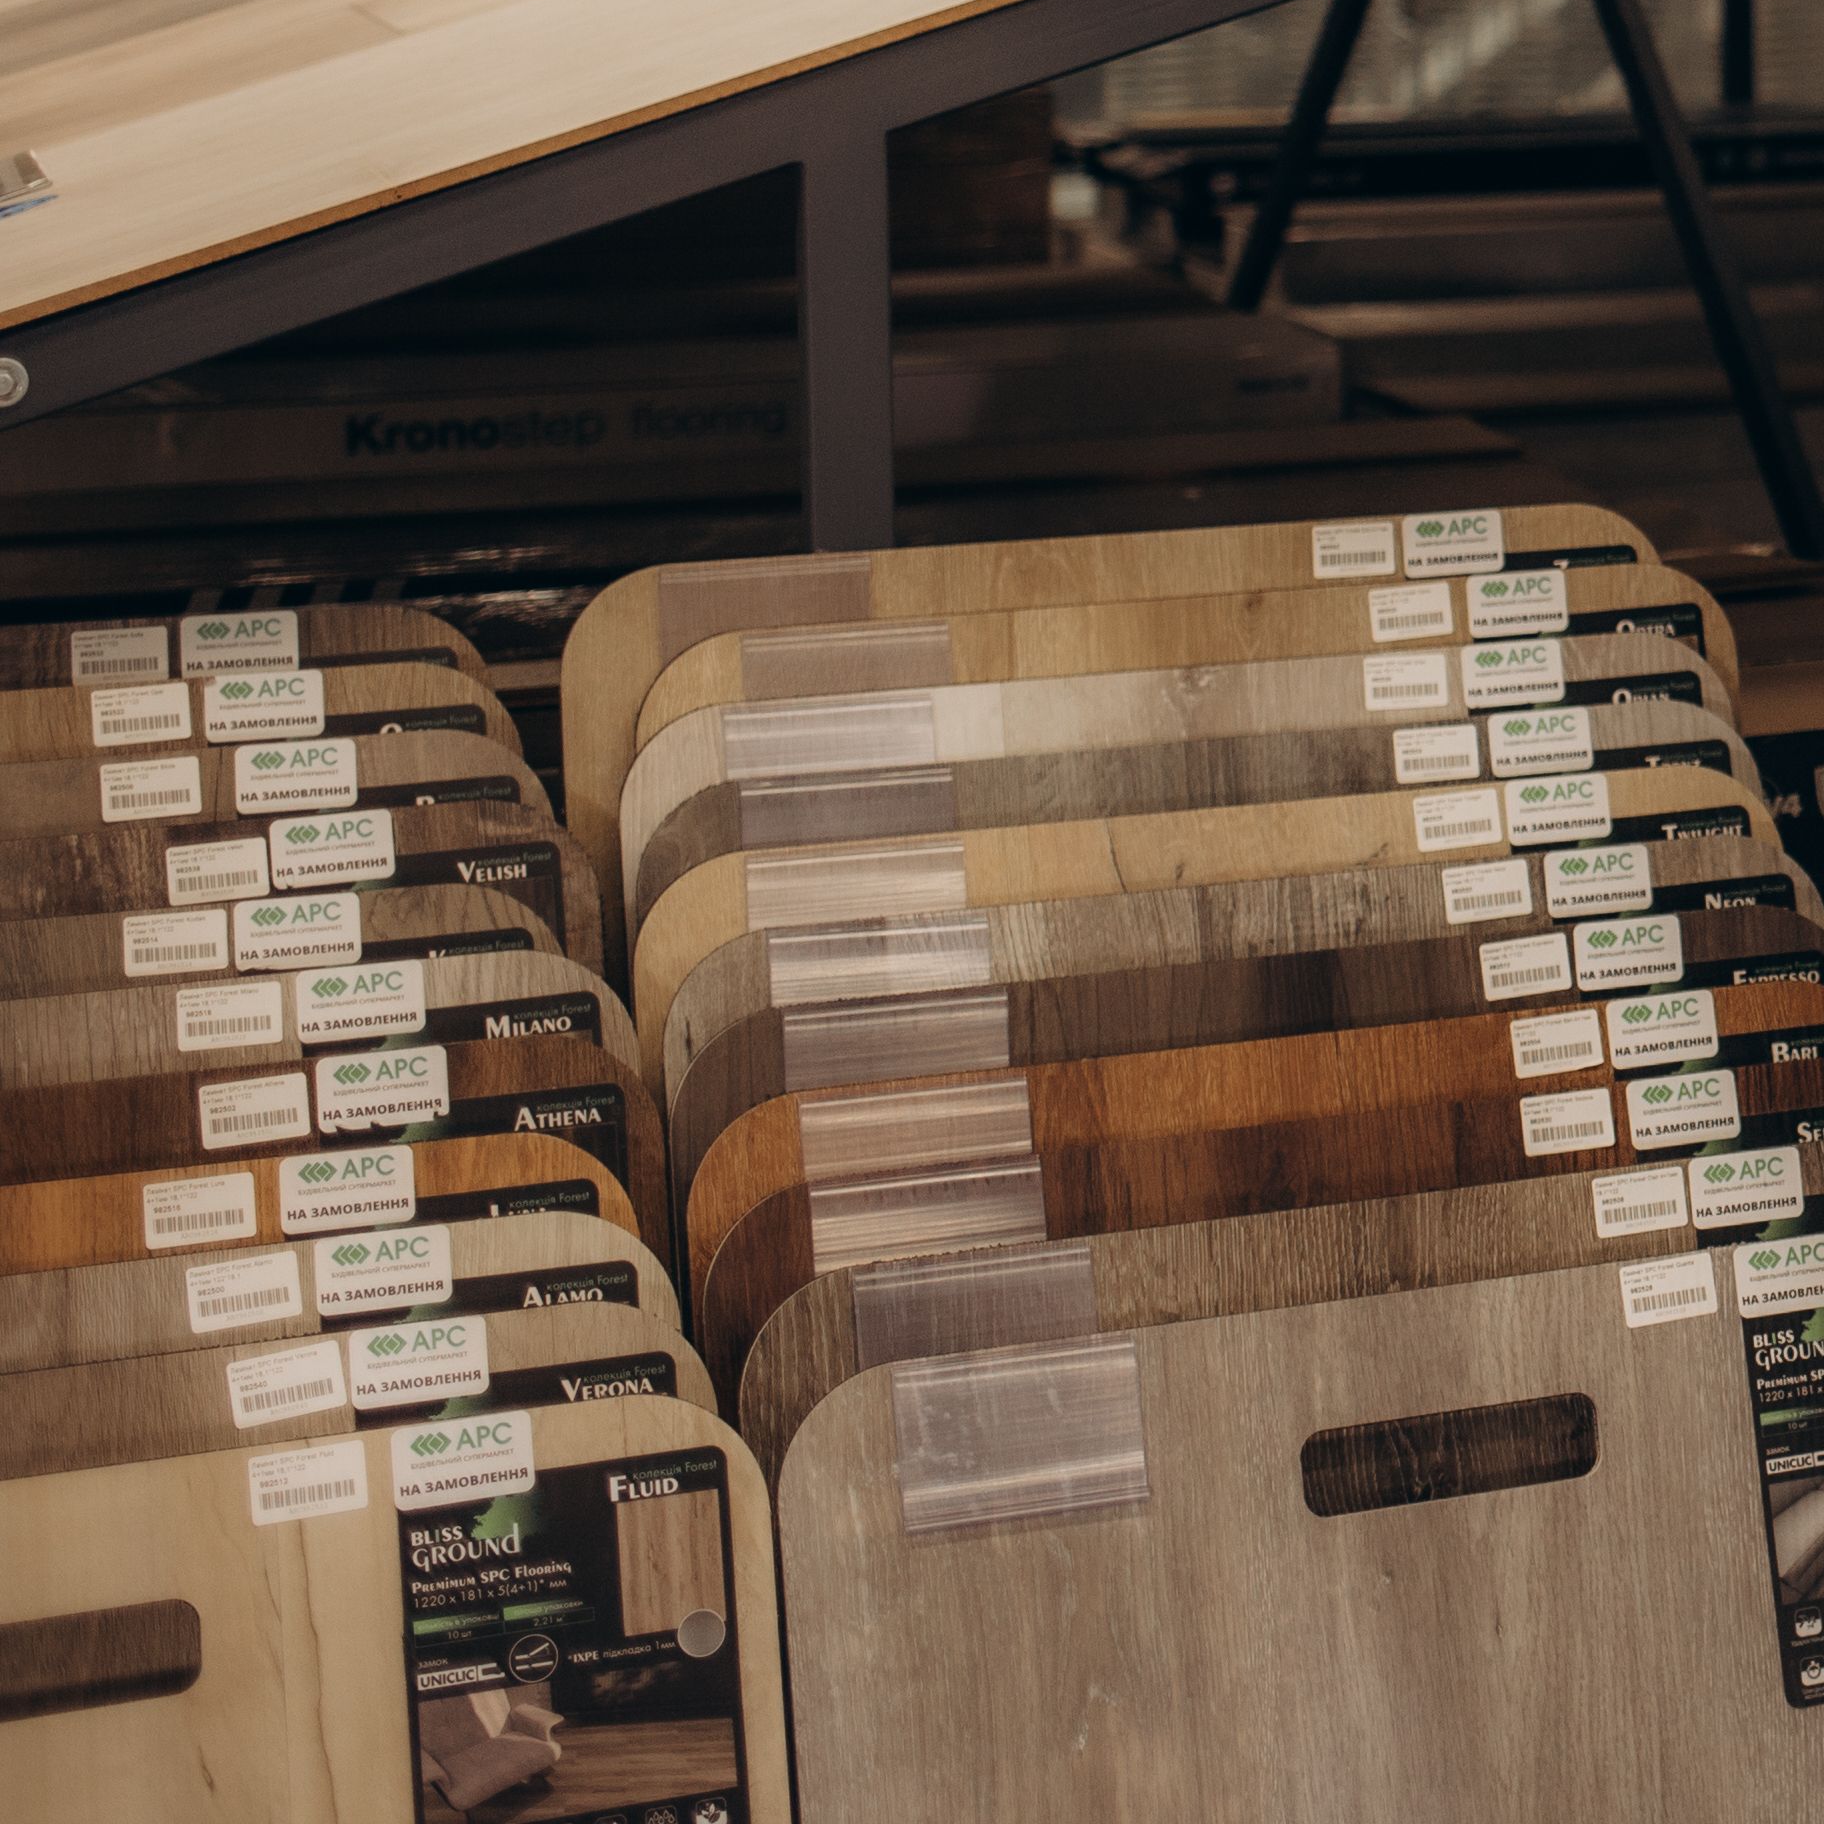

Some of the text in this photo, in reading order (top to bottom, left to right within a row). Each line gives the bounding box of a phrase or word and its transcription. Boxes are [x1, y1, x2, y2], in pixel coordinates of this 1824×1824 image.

[208, 657, 293, 670] ЗАМОВЛЕННЯ
[231, 716, 317, 729] ЗАМОВЛЕННЯ
[263, 786, 350, 801] ЗАМОВЛЕННЯ
[276, 857, 387, 877] НА ЗАМОВЛЕННЯ
[457, 860, 527, 883] VELISH
[1571, 890, 1646, 905] ЗАМОВЛЕННЯ
[241, 942, 354, 960] НА ЗАМОВЛЕННЯ
[1600, 962, 1676, 979] ЗАМОВЛЕННЯ
[301, 1012, 417, 1033] НА ЗАМОВЛЕННЯ
[485, 1015, 571, 1039] MILANO
[1616, 1036, 1712, 1057] НА ЗАМОВЛЕННЯ
[1771, 1042, 1818, 1064] BARI
[323, 1098, 441, 1121] НА ЗАМОВЛЕННЯ
[514, 1107, 601, 1132] ATHENA
[1636, 1117, 1734, 1138] НА ЗАМОВЛЕННЯ
[560, 1192, 590, 1202] Forest
[1696, 1197, 1797, 1217] НА ЗАМОВЛЕННЯ
[288, 1198, 409, 1220] НА ЗАМОВЛЕННЯ
[598, 1274, 628, 1284] Forest
[321, 1280, 444, 1304] НА ЗАМОВЛЕННЯ
[1742, 1296, 1758, 1306] НА
[1753, 1330, 1794, 1348] BLISS
[635, 1364, 666, 1376] Forest
[357, 1370, 481, 1396] НА ЗАМОВЛЕННЯ
[561, 1377, 653, 1402] VERONA
[1760, 1391, 1784, 1403] 1220
[1797, 1385, 1813, 1397] 181
[685, 1461, 717, 1472] Forest
[400, 1467, 528, 1497] НА ЗАМОВЛЕННЯ
[610, 1475, 678, 1502] FLUID
[411, 1526, 463, 1547] BLISS
[480, 1569, 510, 1584] SPC
[414, 1595, 446, 1609] 1220
[461, 1589, 484, 1602] 181
[448, 1630, 459, 1640] 10
[602, 1643, 651, 1658] підкладка
[420, 1670, 475, 1688] UNICLIC
